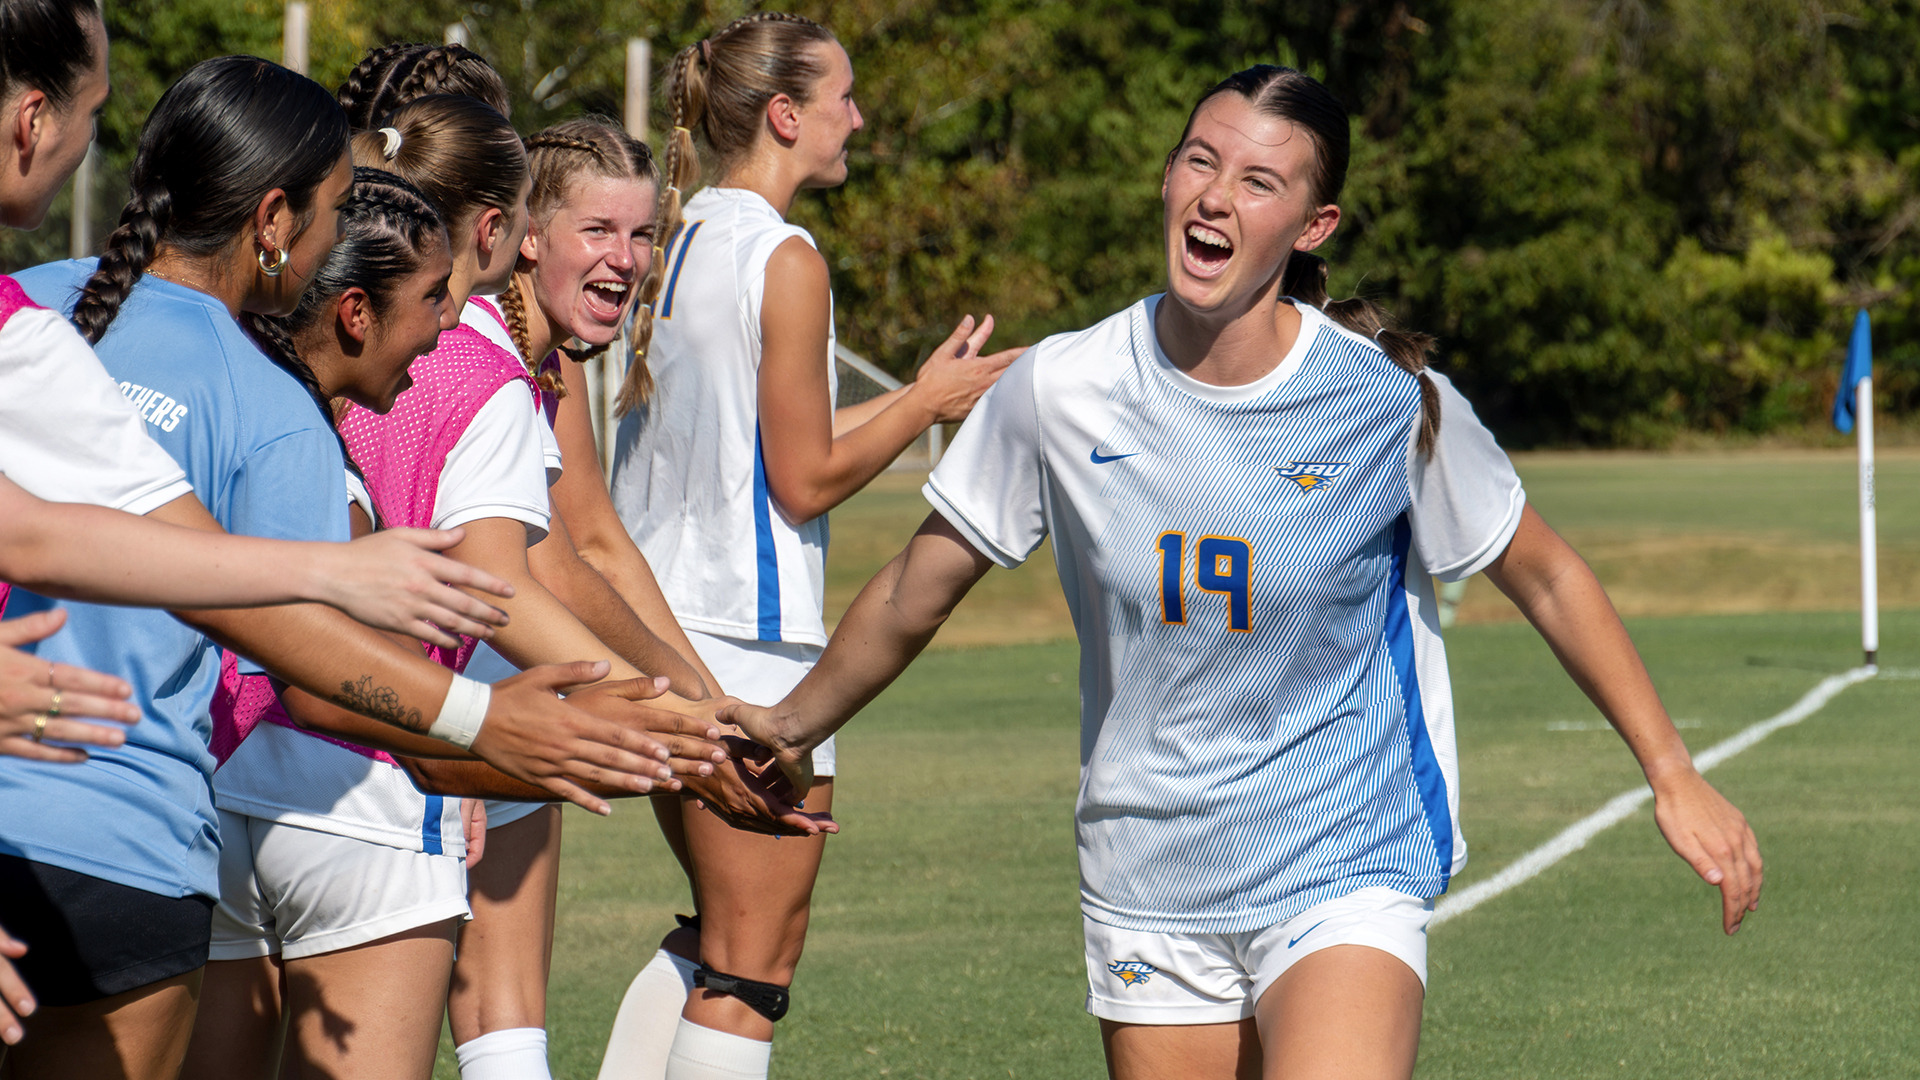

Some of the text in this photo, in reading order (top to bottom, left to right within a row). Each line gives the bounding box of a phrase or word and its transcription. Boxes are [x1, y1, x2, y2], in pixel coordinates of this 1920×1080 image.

[114, 379, 188, 433] OTHERS
[1279, 462, 1349, 477] JBU
[1155, 530, 1254, 634] 19
